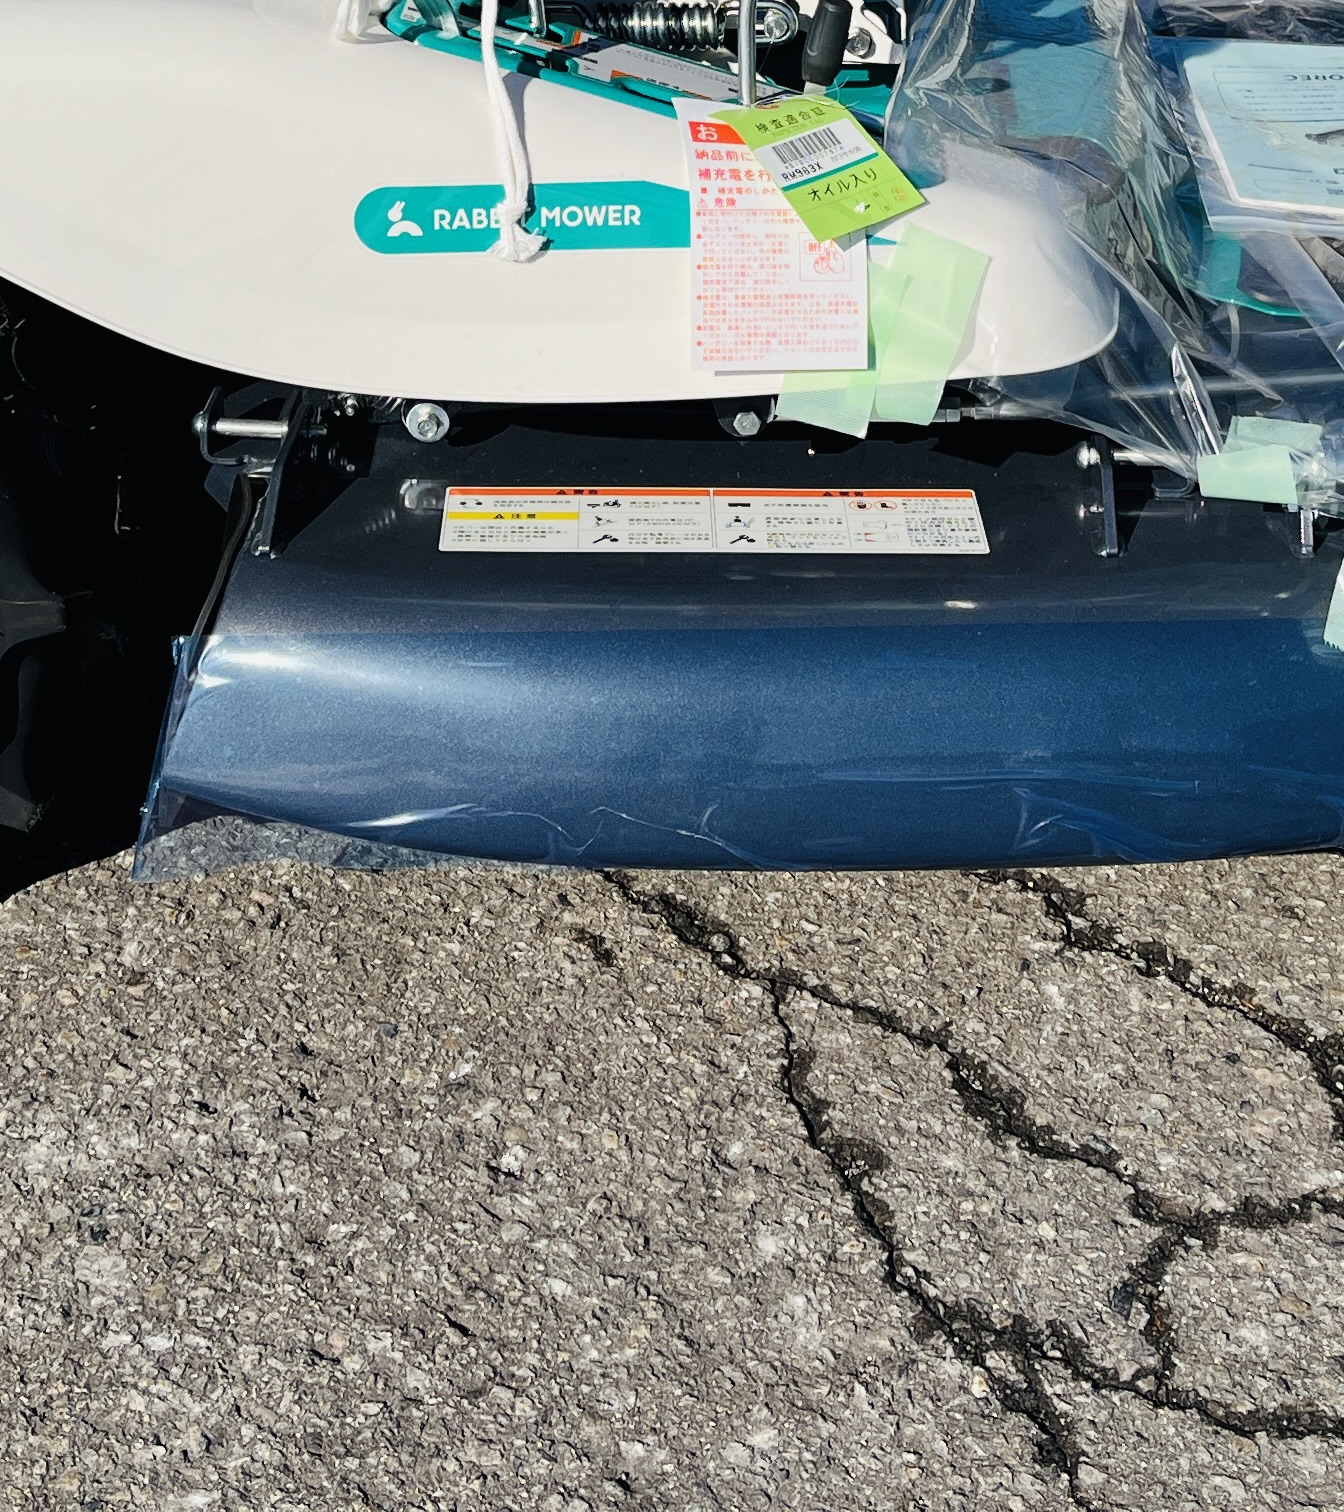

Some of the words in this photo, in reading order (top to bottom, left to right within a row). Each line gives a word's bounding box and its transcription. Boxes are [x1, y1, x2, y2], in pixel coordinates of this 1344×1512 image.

[696, 123, 718, 141] お
[780, 162, 824, 183] RM983X
[807, 167, 878, 202] オイル入り
[714, 197, 737, 208] 危険
[433, 206, 526, 231] RABB
[540, 204, 642, 228] MOWER
